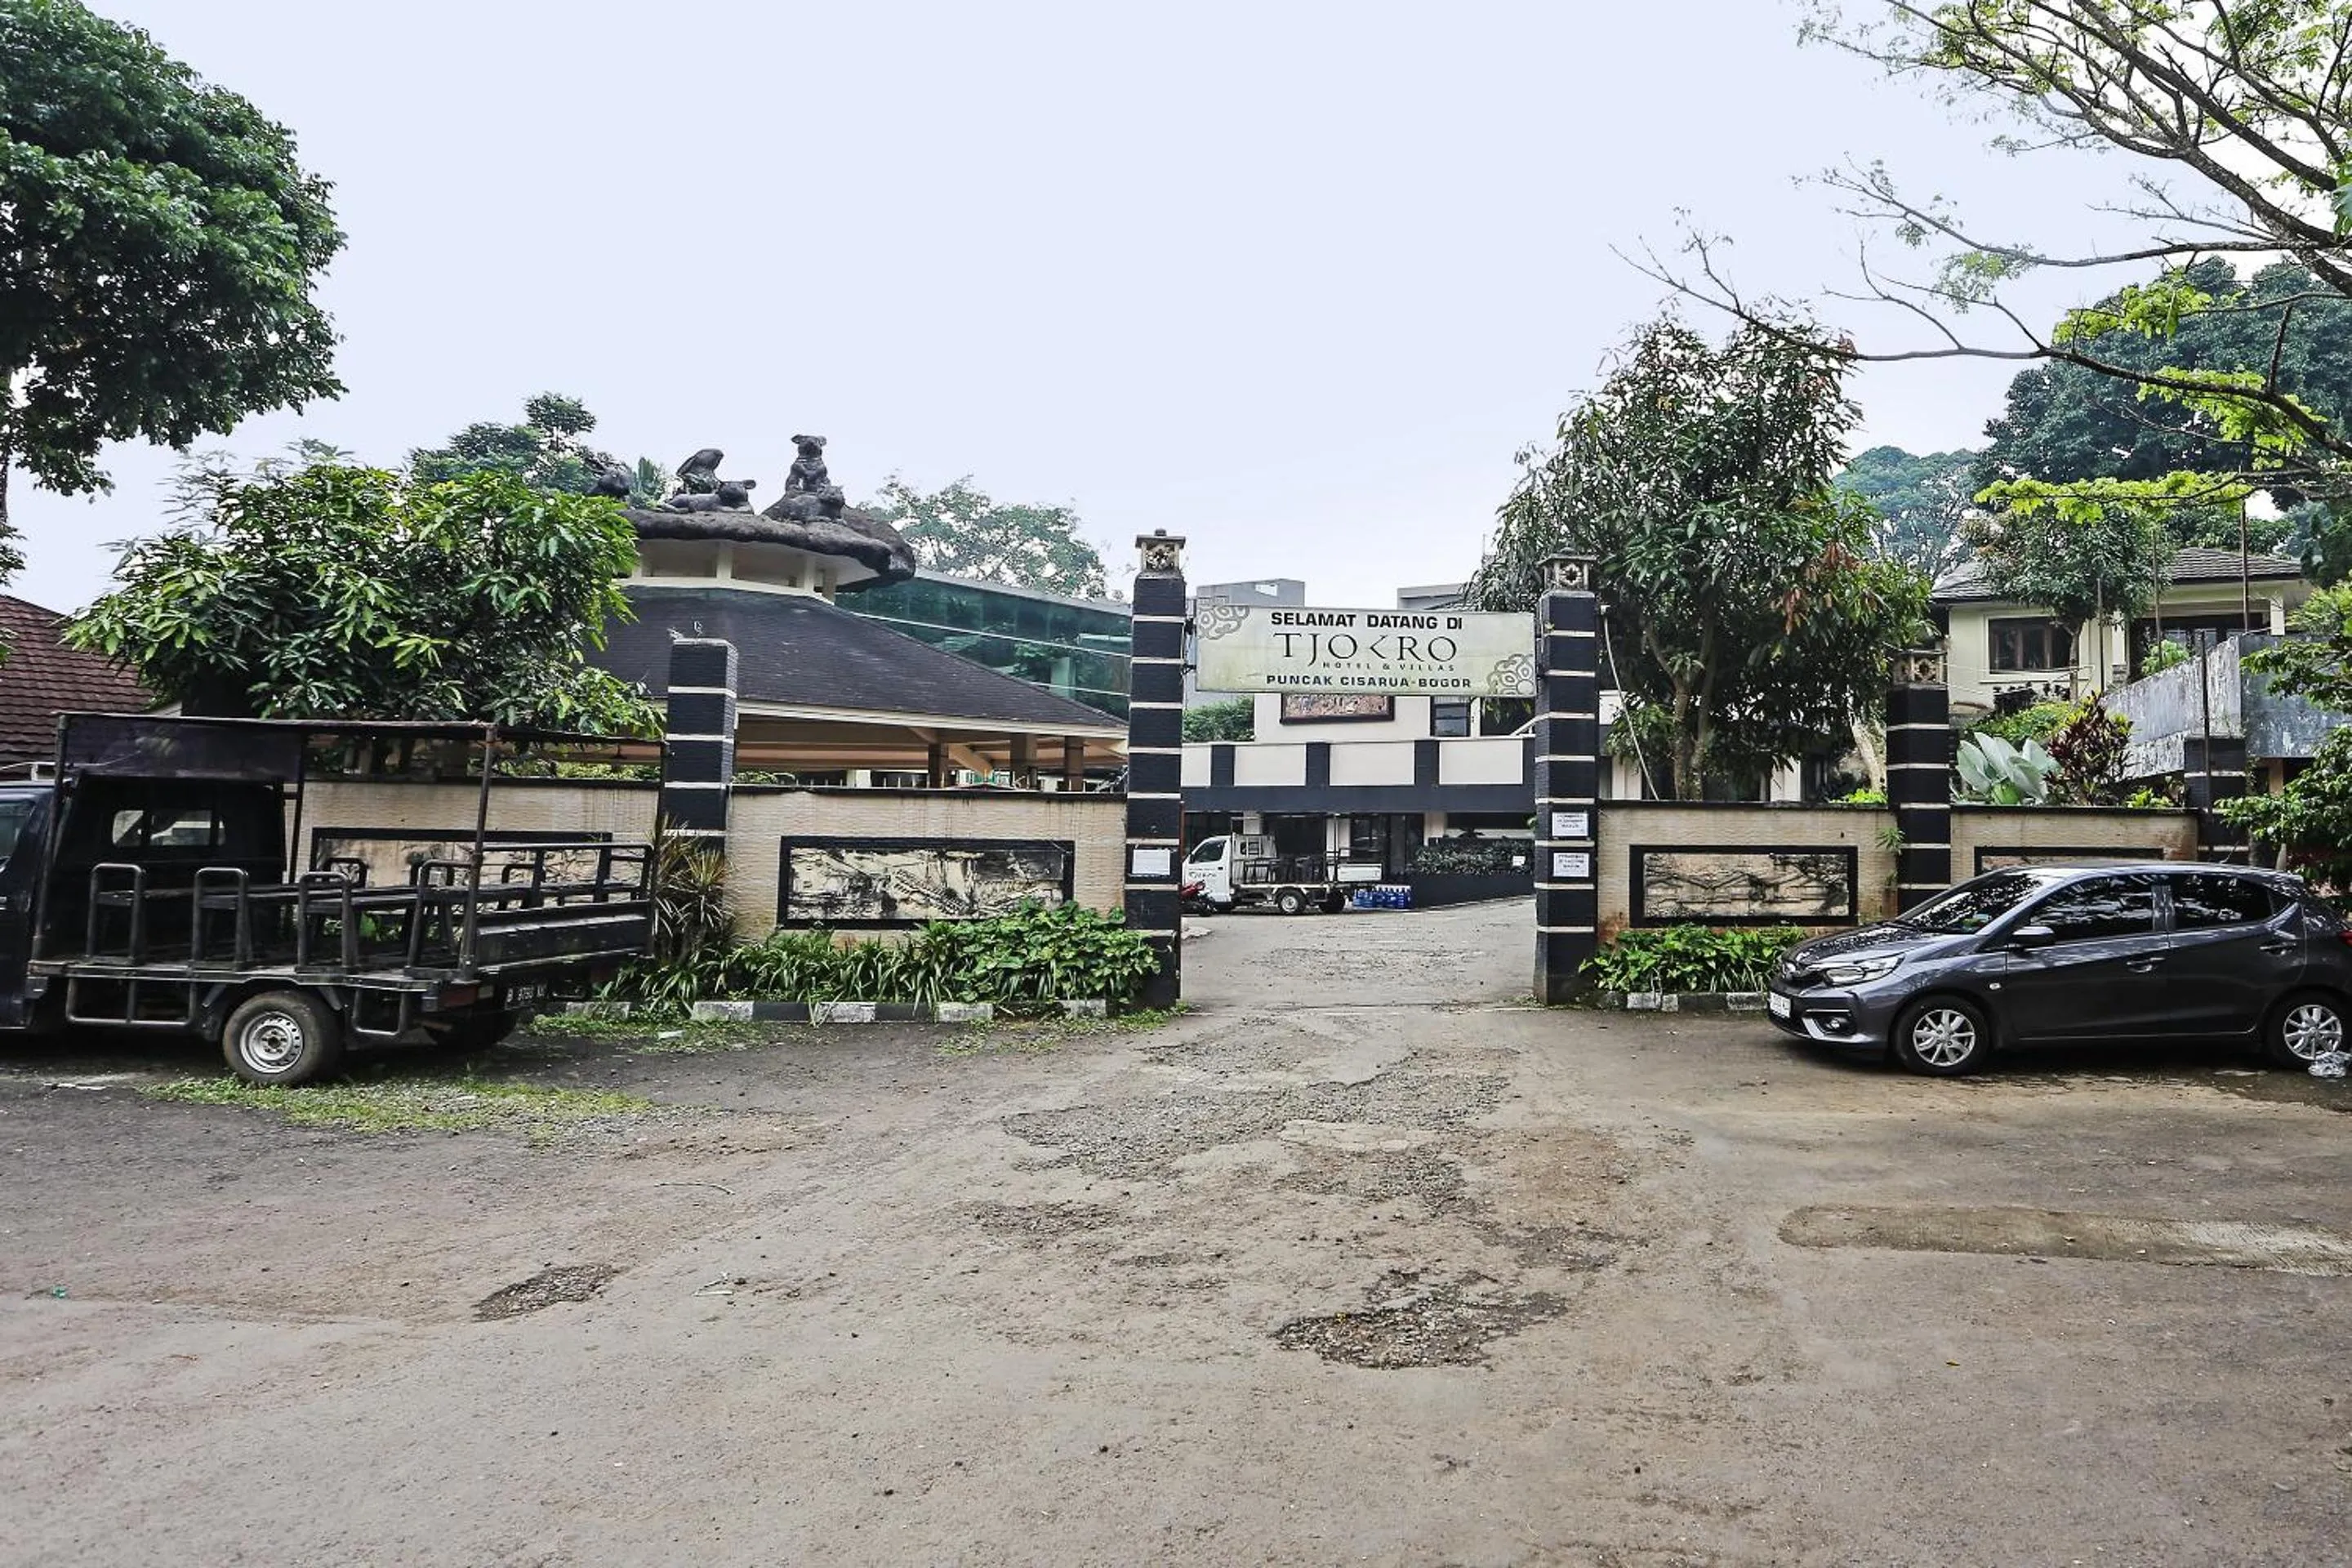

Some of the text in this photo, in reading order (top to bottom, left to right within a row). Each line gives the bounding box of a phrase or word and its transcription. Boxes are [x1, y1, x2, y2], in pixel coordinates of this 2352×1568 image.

[1271, 612, 1463, 630] SELAMAT DATANG DI
[1272, 632, 1457, 667] TJOKRO
[1322, 662, 1371, 670] HOTEL
[1382, 662, 1391, 670] &
[1266, 675, 1333, 685] PUNCAK
